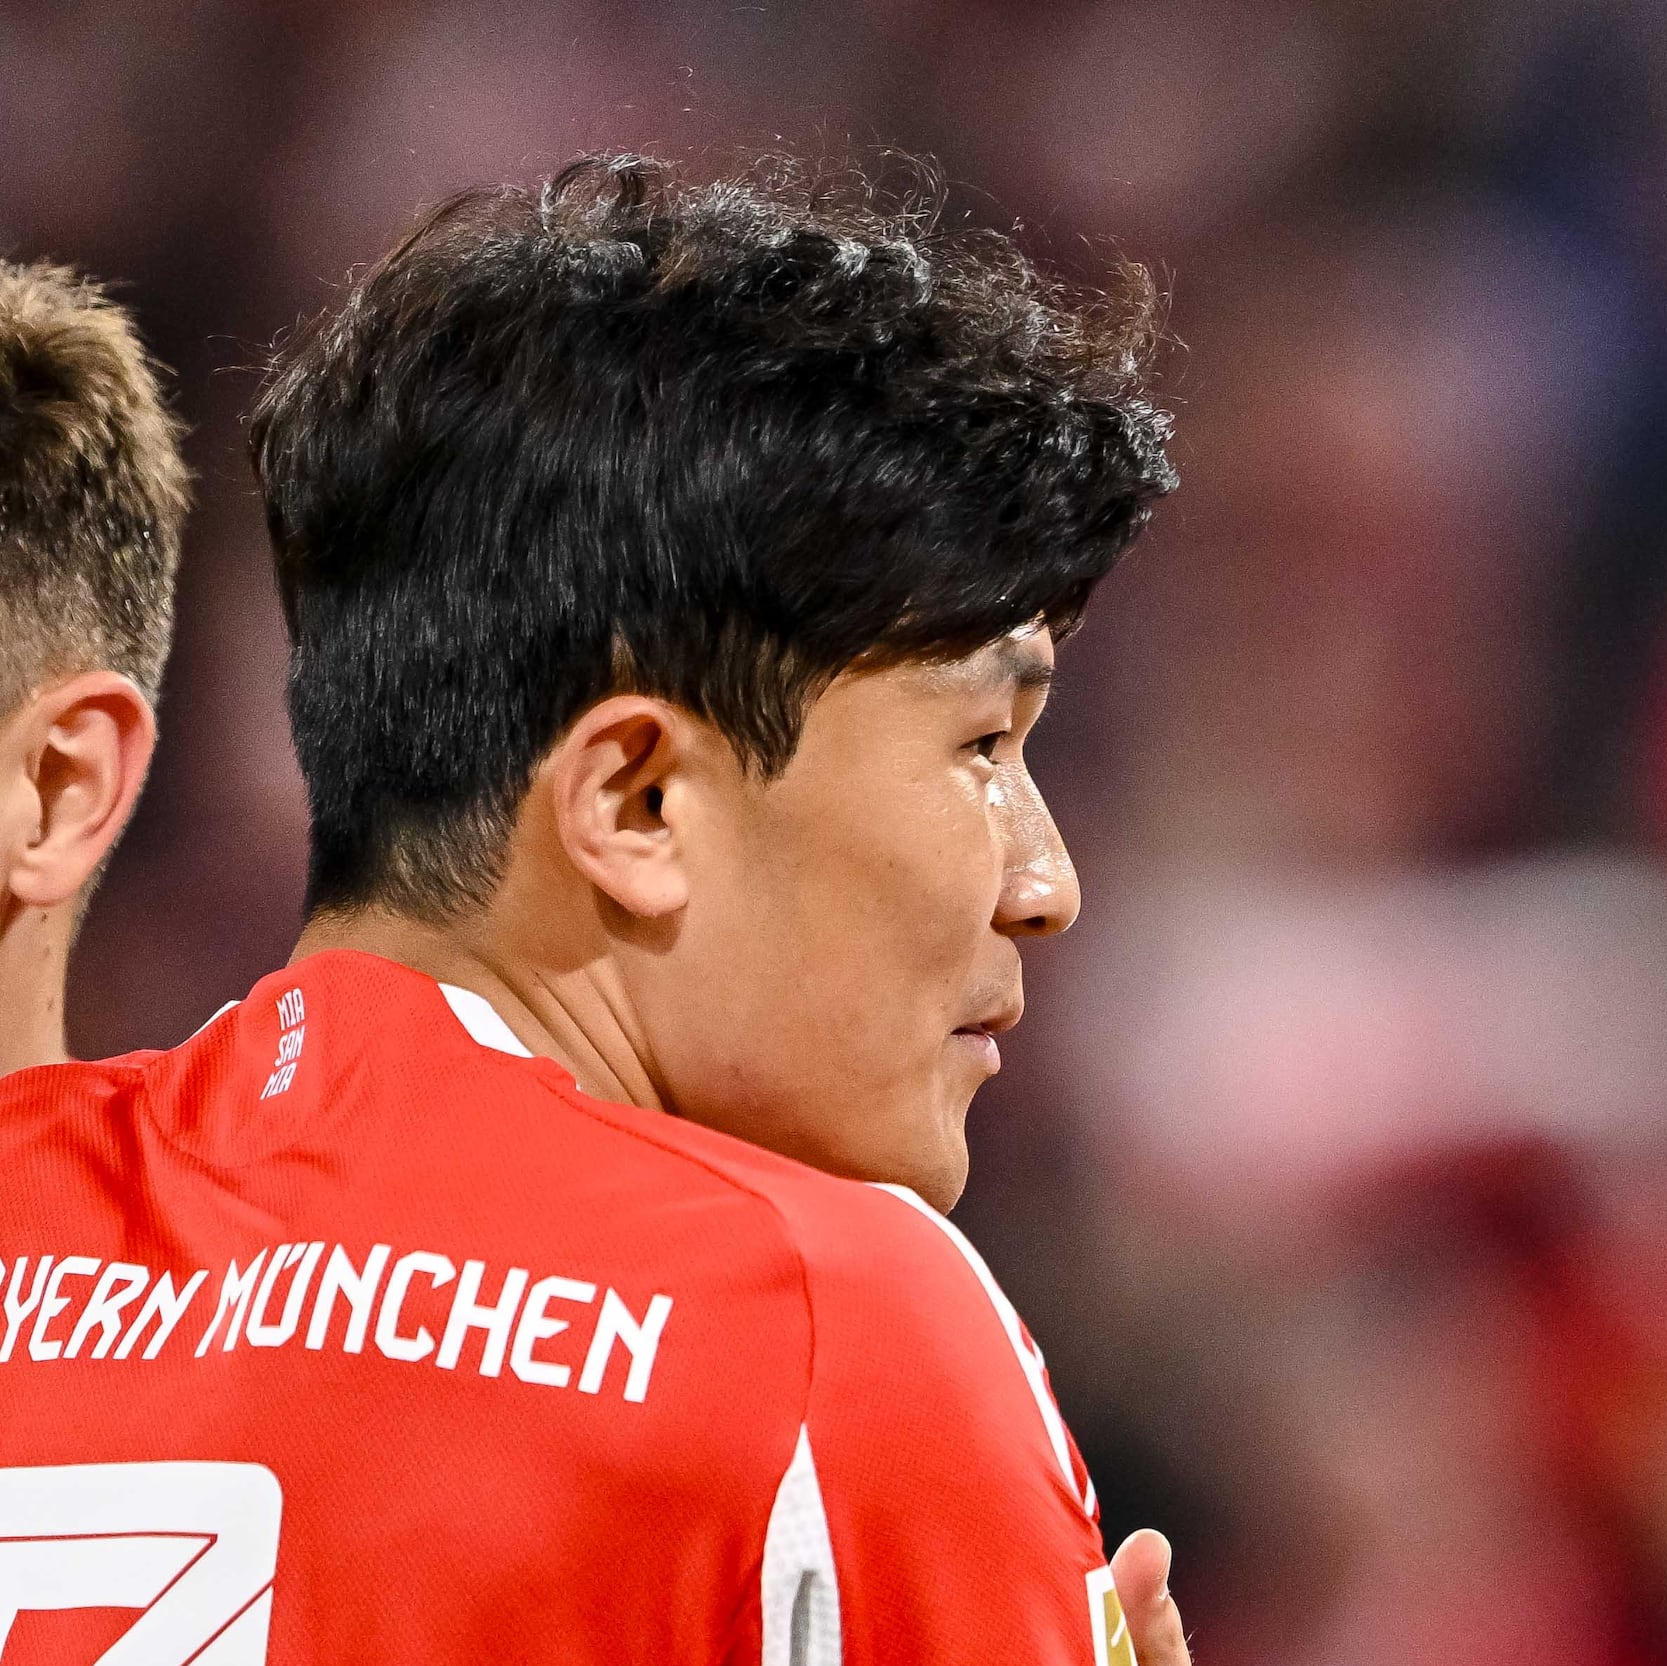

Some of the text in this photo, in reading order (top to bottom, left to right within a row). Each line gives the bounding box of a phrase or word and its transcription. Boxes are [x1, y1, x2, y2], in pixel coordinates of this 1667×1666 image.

[276, 988, 305, 1031] MIA
[275, 1025, 305, 1067] SAN
[260, 1062, 297, 1100] MIA
[0, 1241, 674, 1403] YERN MÜNCHEN
